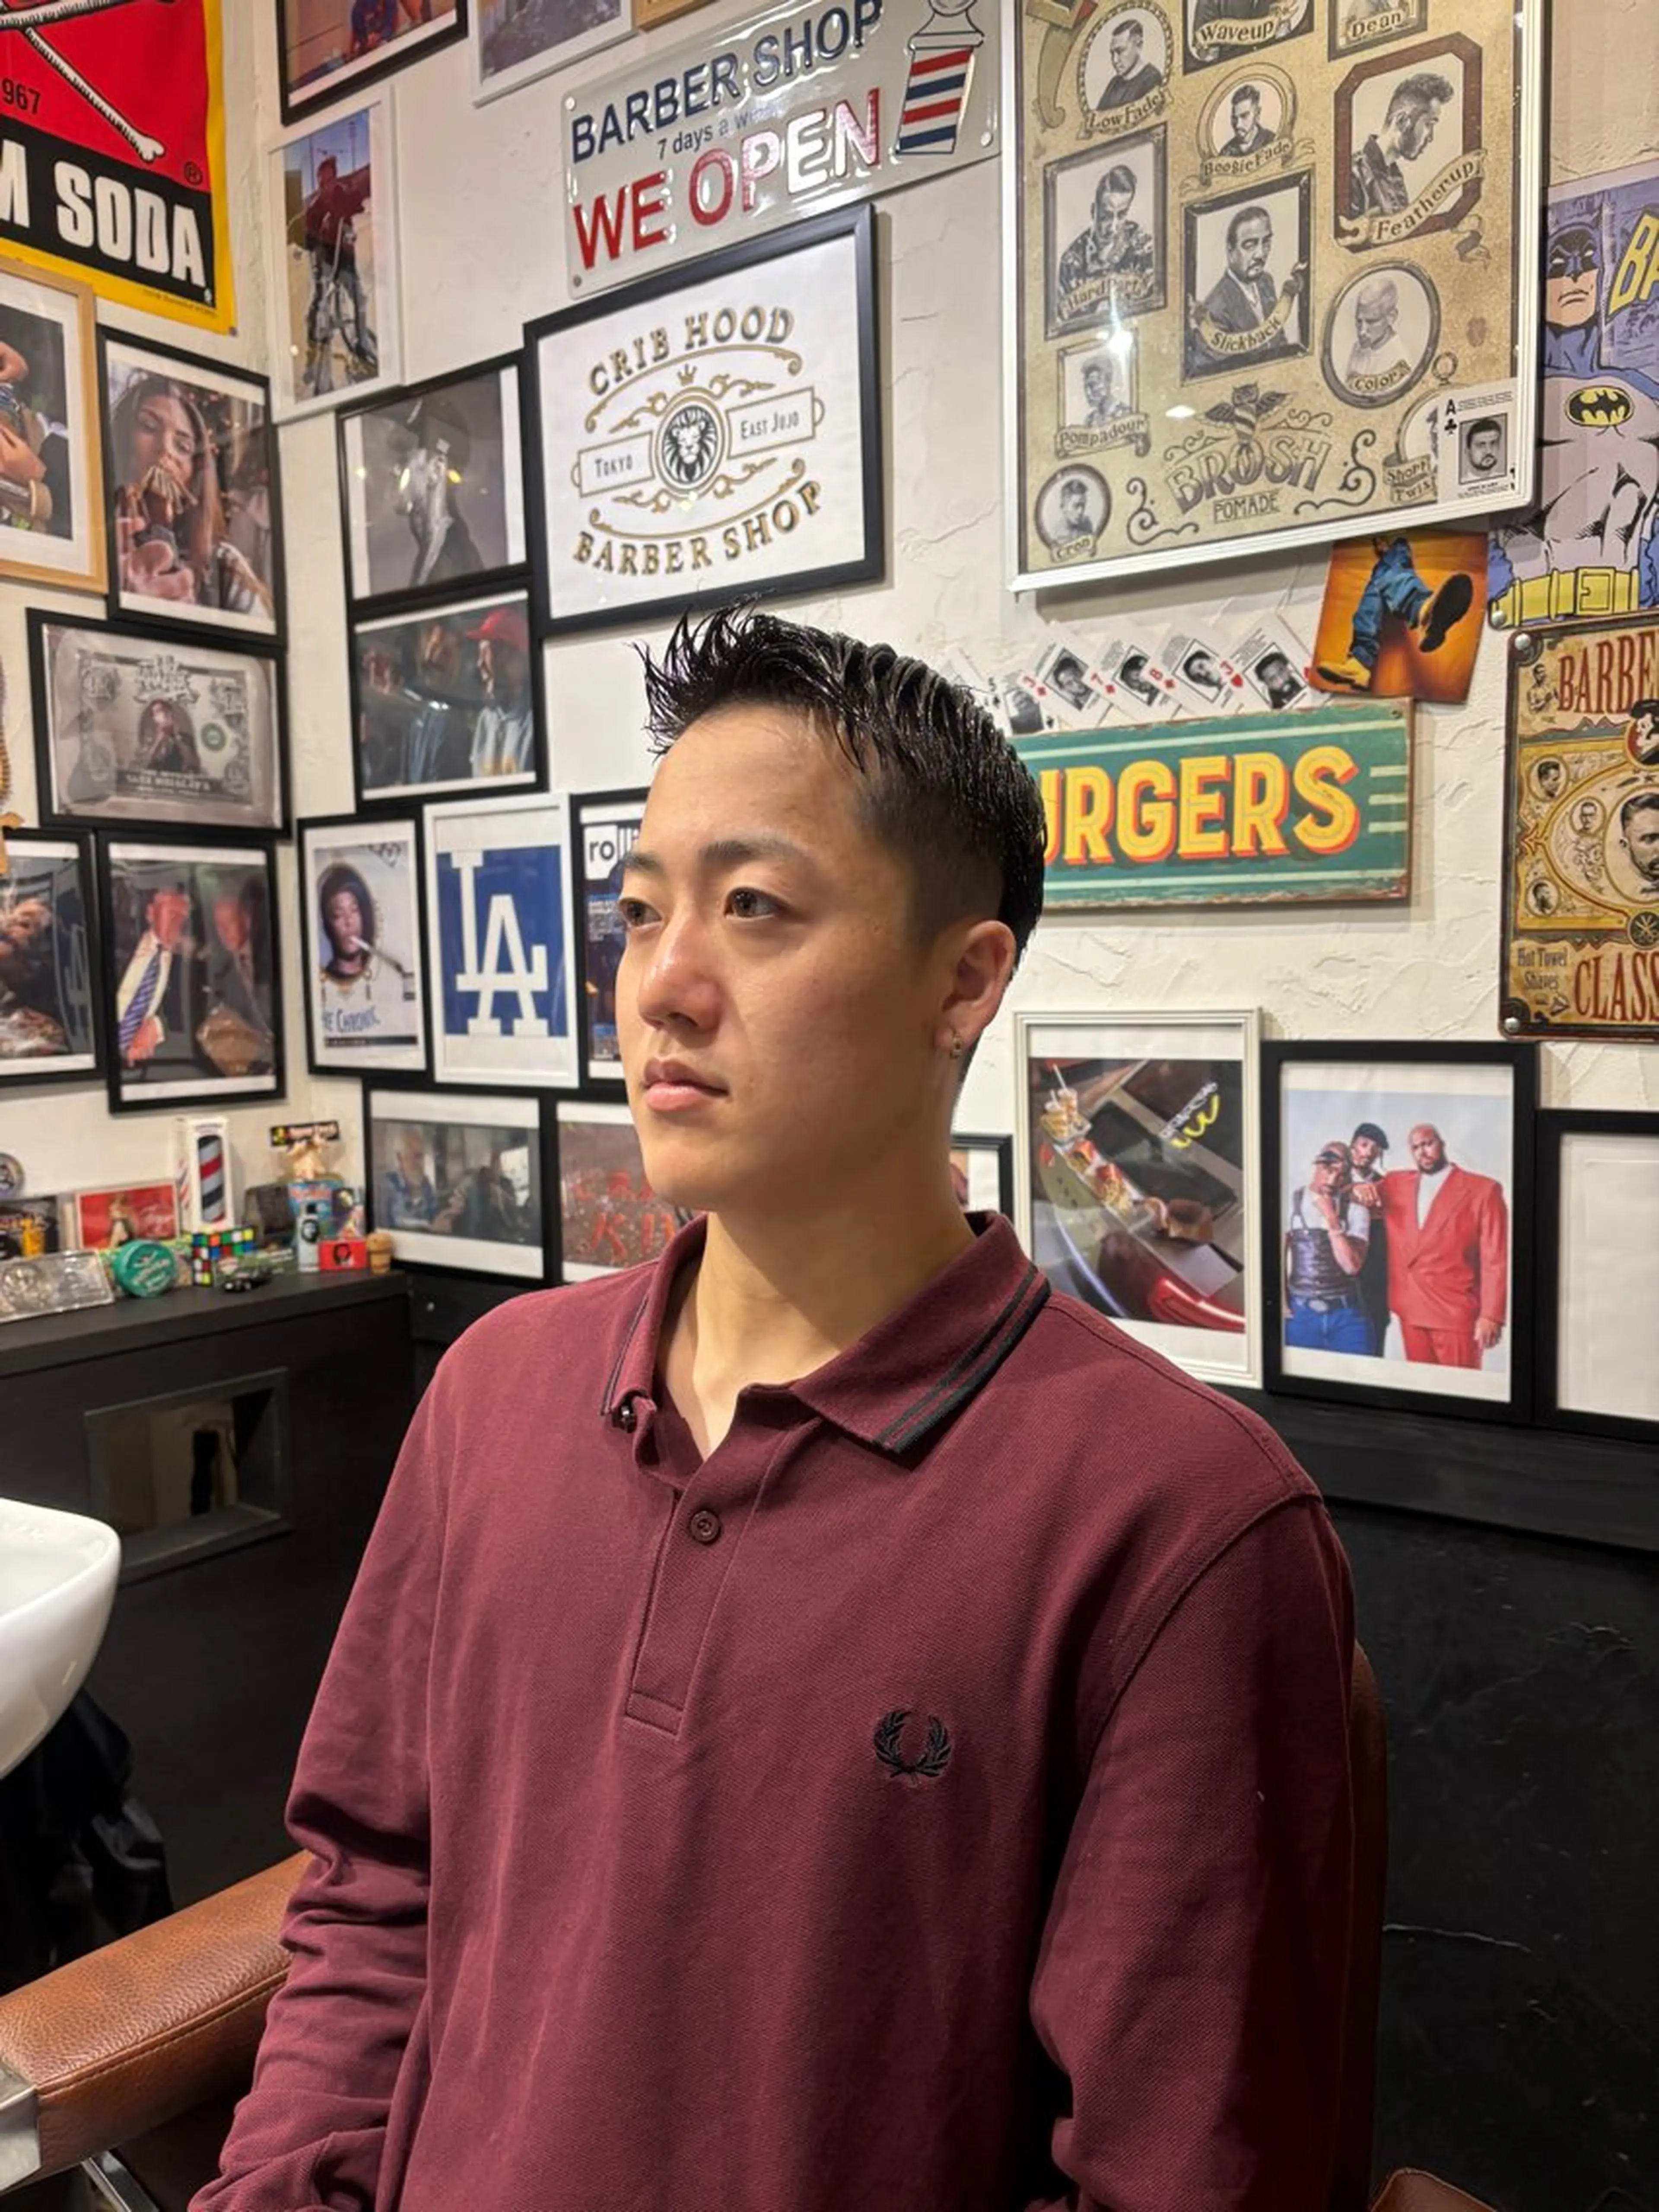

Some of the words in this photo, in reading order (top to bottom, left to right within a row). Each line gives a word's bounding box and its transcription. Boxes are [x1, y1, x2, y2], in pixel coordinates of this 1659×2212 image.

[1199, 20, 1274, 42] Waveup
[1351, 12, 1402, 38] Dean
[2, 78, 41, 114] 967
[573, 52, 740, 163] BARBER
[753, 0, 882, 87] SHOP
[1089, 113, 1123, 128] Low
[1125, 95, 1159, 124] Fade
[658, 137, 667, 160] 7
[673, 124, 713, 153] days
[719, 118, 729, 136] a
[1205, 159, 1253, 175] Boogie
[1256, 142, 1290, 166] Fade
[573, 172, 668, 269] WE
[689, 88, 880, 226] OPEN
[1376, 162, 1475, 240] Featherup
[54, 161, 206, 288] SODA
[589, 327, 670, 396] CRIB
[684, 306, 795, 350] HOOD
[1211, 319, 1280, 353] Slickback
[1445, 398, 1456, 416] A
[741, 420, 768, 440] EAST
[1059, 417, 1145, 445] Pompadour
[594, 454, 633, 478] TOKYO
[1168, 435, 1332, 514] BROSH
[1214, 493, 1280, 522] POMADE
[572, 532, 713, 576] BARBER
[721, 480, 823, 561] SHOP
[1150, 667, 1163, 681] 8
[451, 850, 549, 1036] LA
